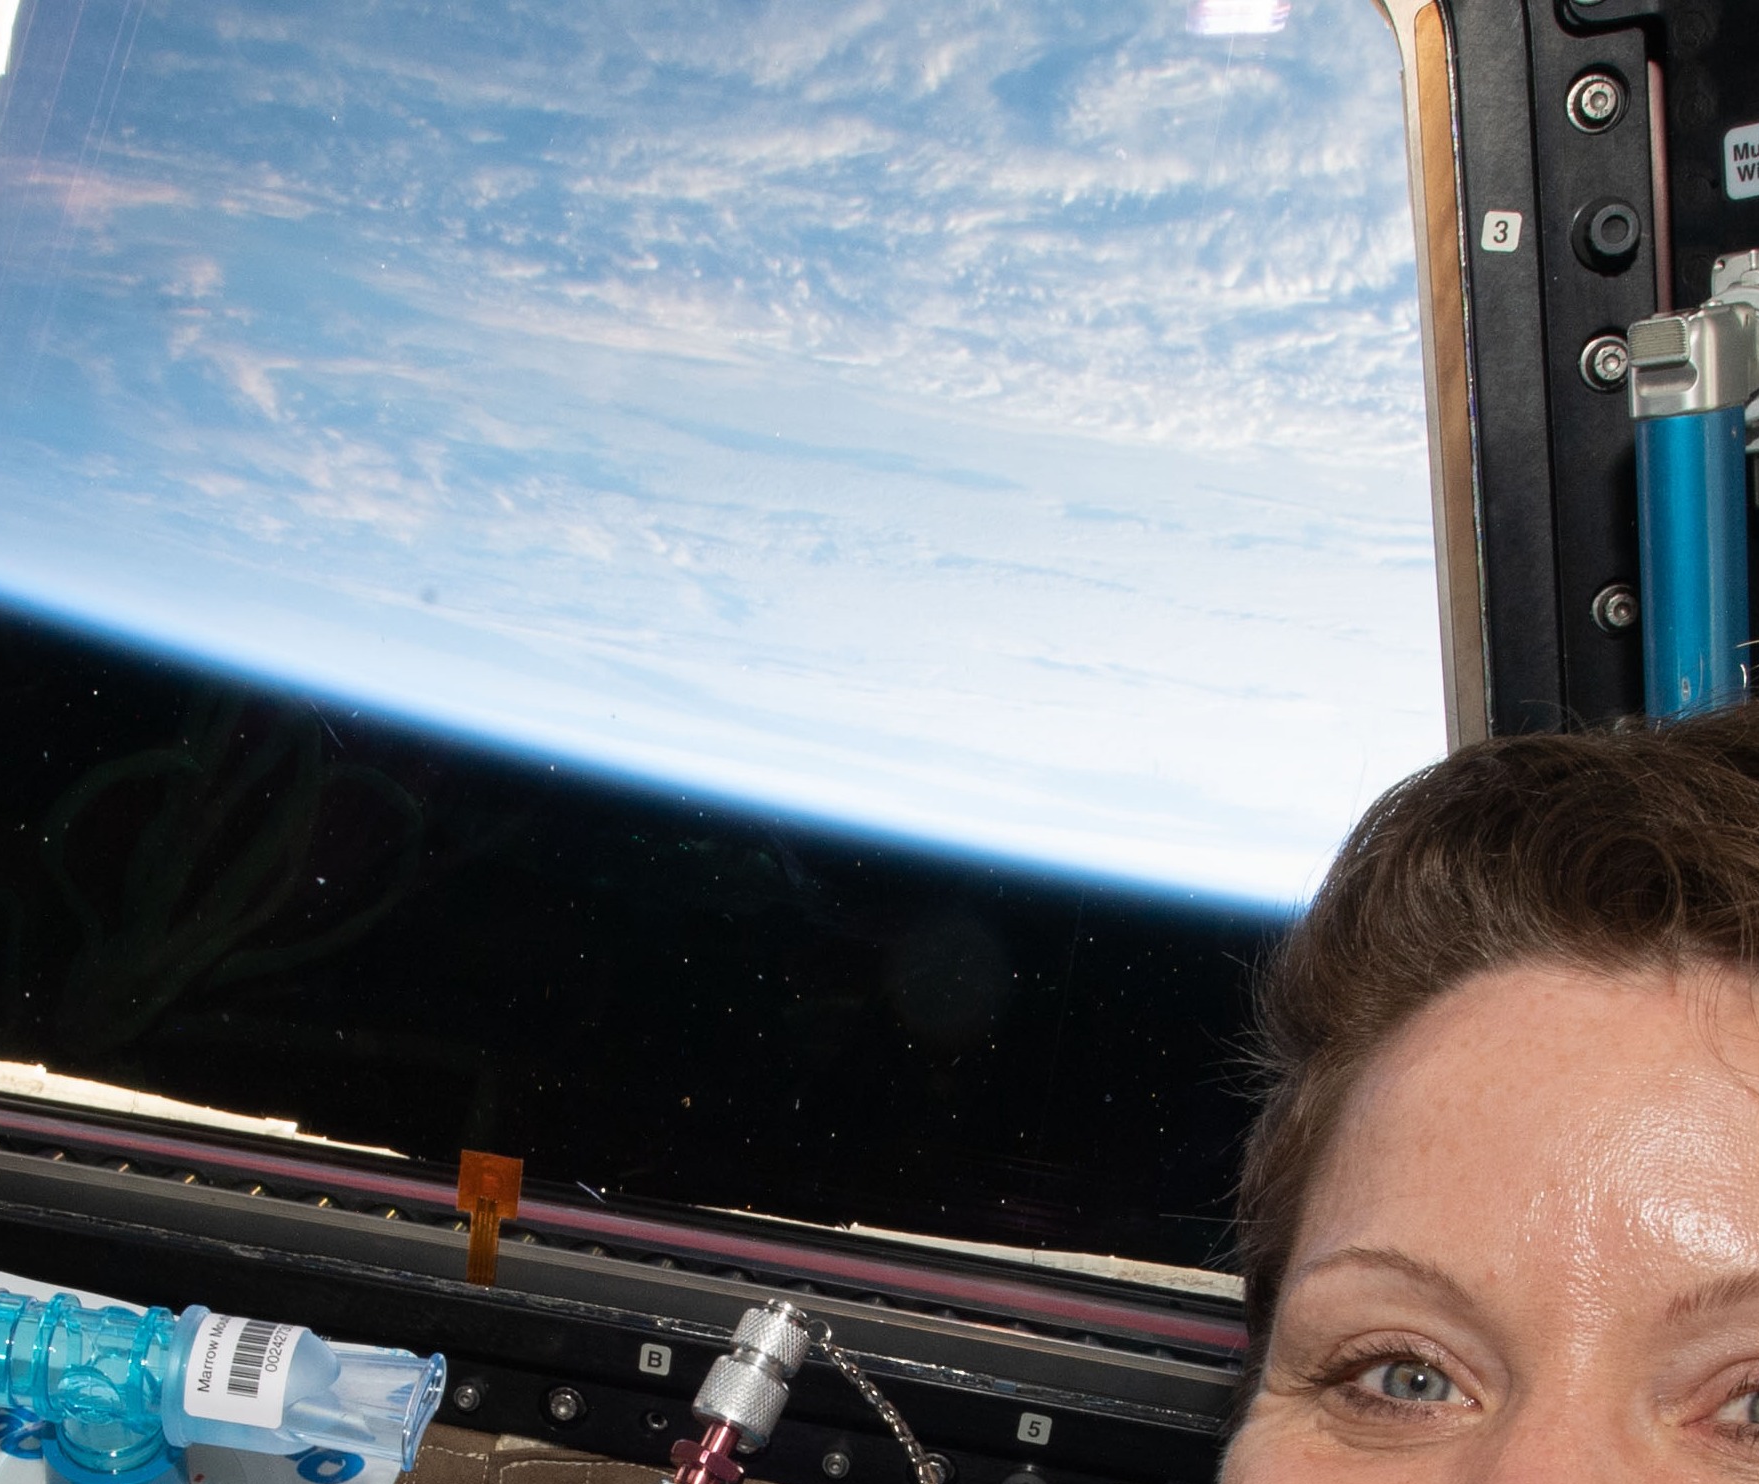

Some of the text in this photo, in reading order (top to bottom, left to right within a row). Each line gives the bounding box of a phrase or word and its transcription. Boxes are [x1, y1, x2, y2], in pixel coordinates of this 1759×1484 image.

[1492, 219, 1509, 245] 3
[197, 1341, 220, 1393] Marrow
[646, 1350, 663, 1369] B
[1026, 1420, 1041, 1438] 5
